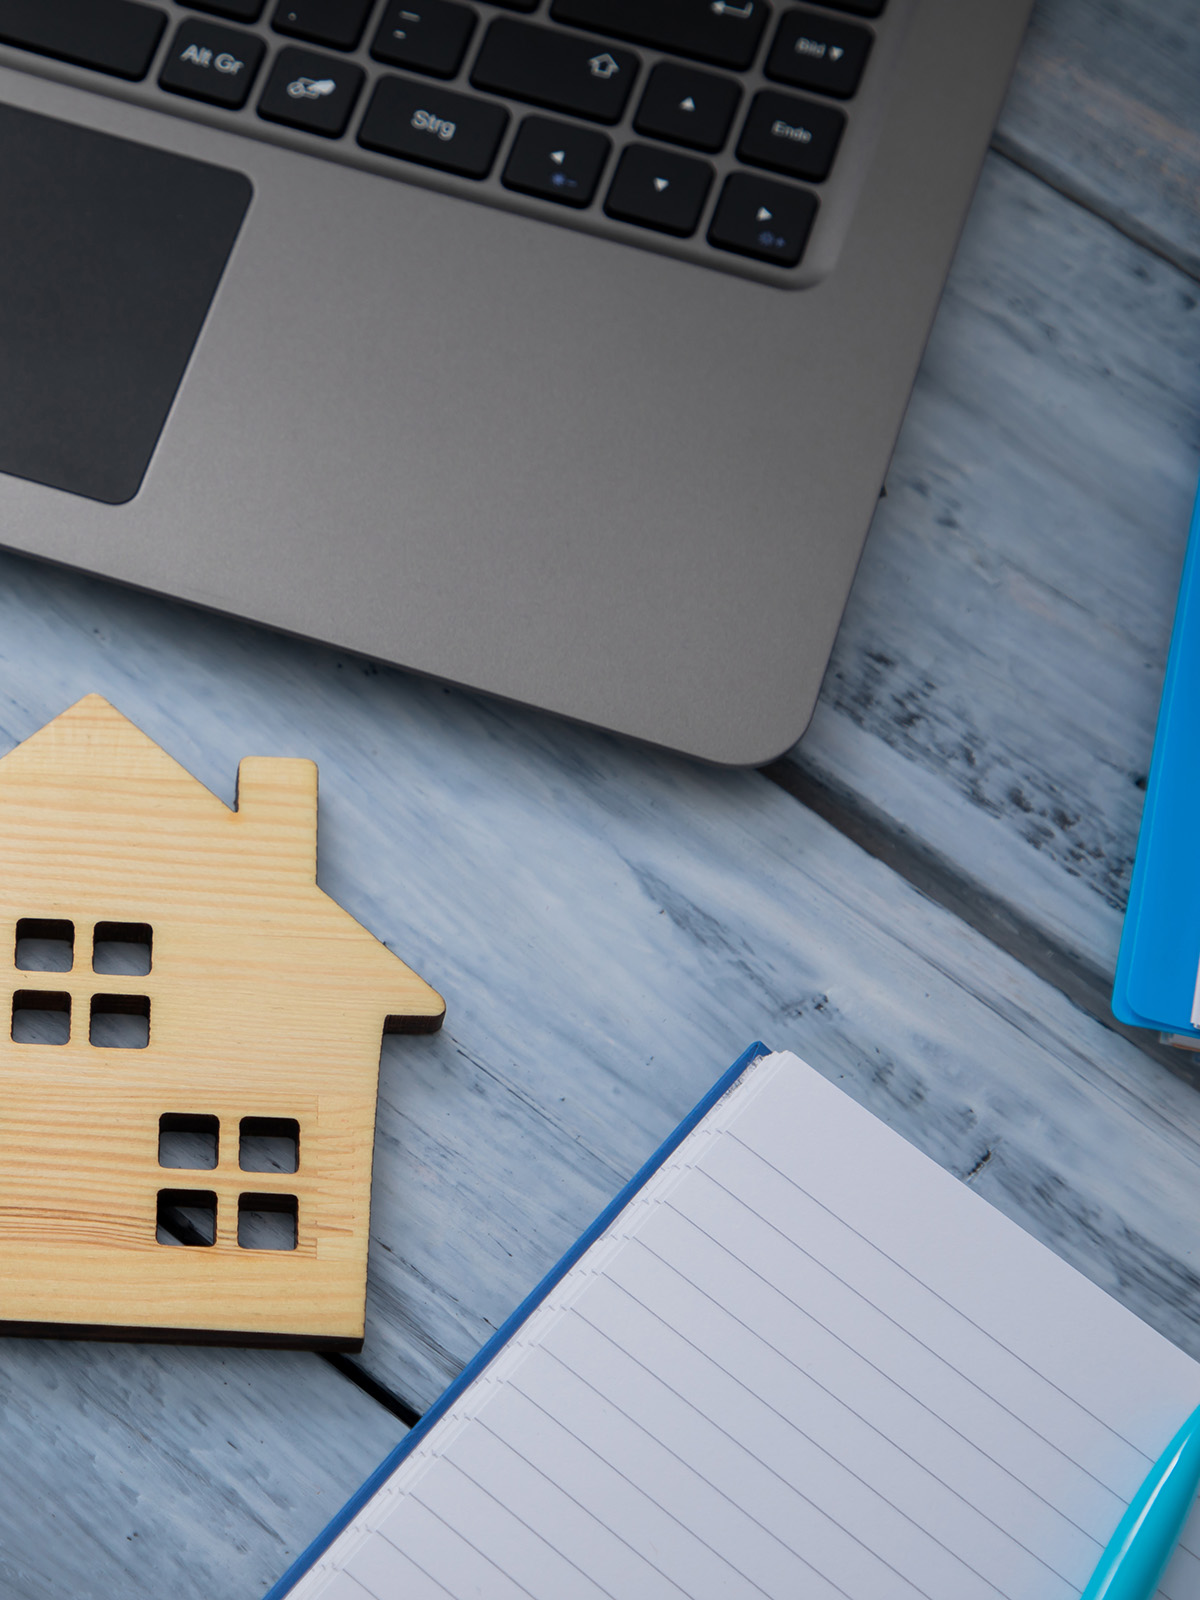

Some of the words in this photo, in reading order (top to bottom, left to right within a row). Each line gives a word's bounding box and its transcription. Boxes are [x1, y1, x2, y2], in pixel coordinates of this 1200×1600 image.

[180, 45, 212, 67] Alt
[214, 53, 243, 74] Gr
[411, 110, 456, 141] Strg
[772, 121, 812, 142] Ende
